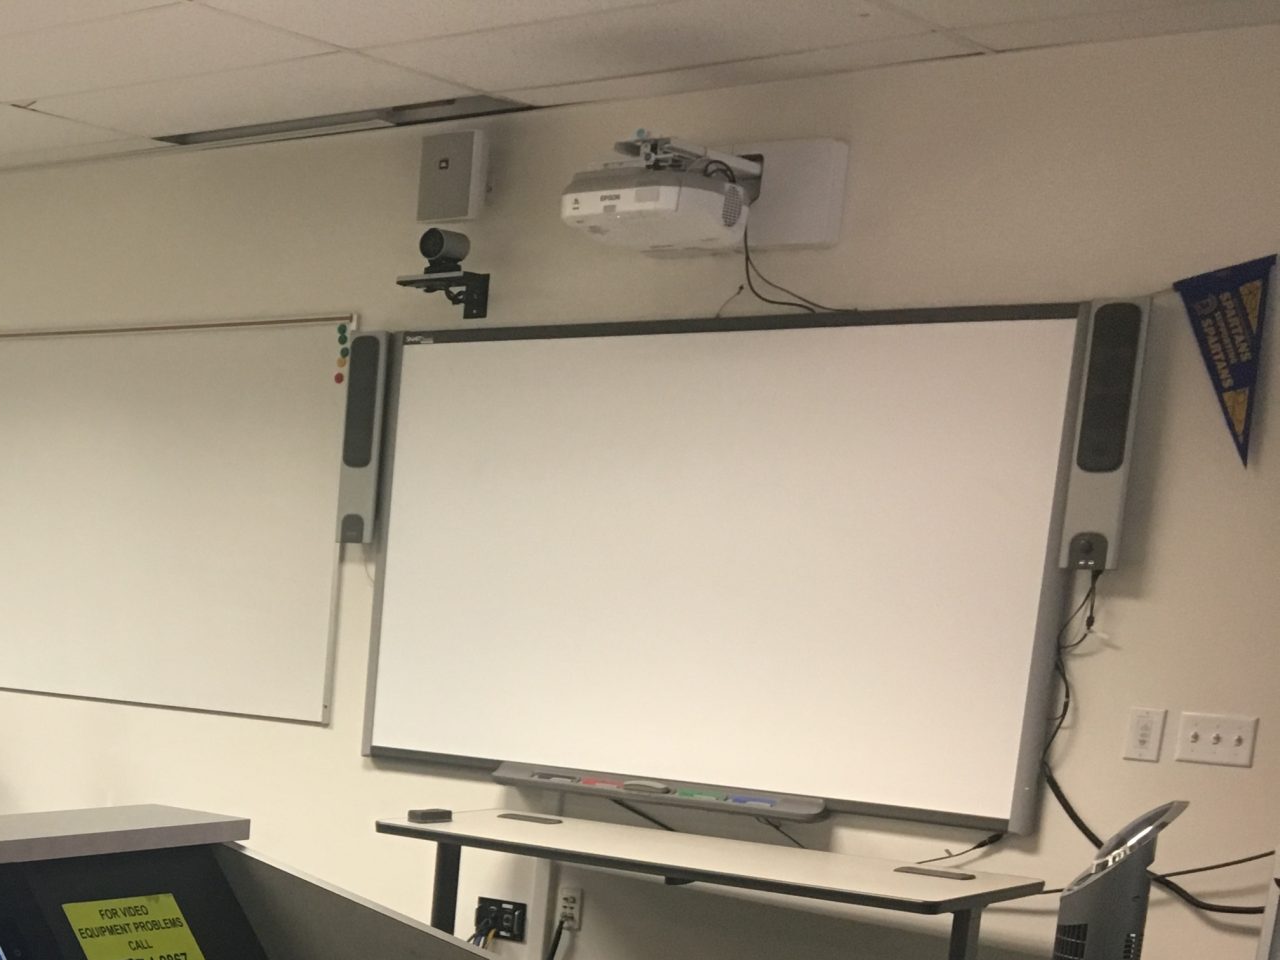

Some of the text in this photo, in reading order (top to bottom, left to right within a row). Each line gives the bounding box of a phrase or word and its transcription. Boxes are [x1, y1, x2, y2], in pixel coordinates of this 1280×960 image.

[1219, 291, 1252, 363] SPARTANS
[1201, 317, 1234, 389] SPARTANS
[98, 904, 149, 920] FOR VIDEO
[78, 917, 184, 940] EQUIPMENT PROBLEMS
[128, 939, 153, 952] CALL
